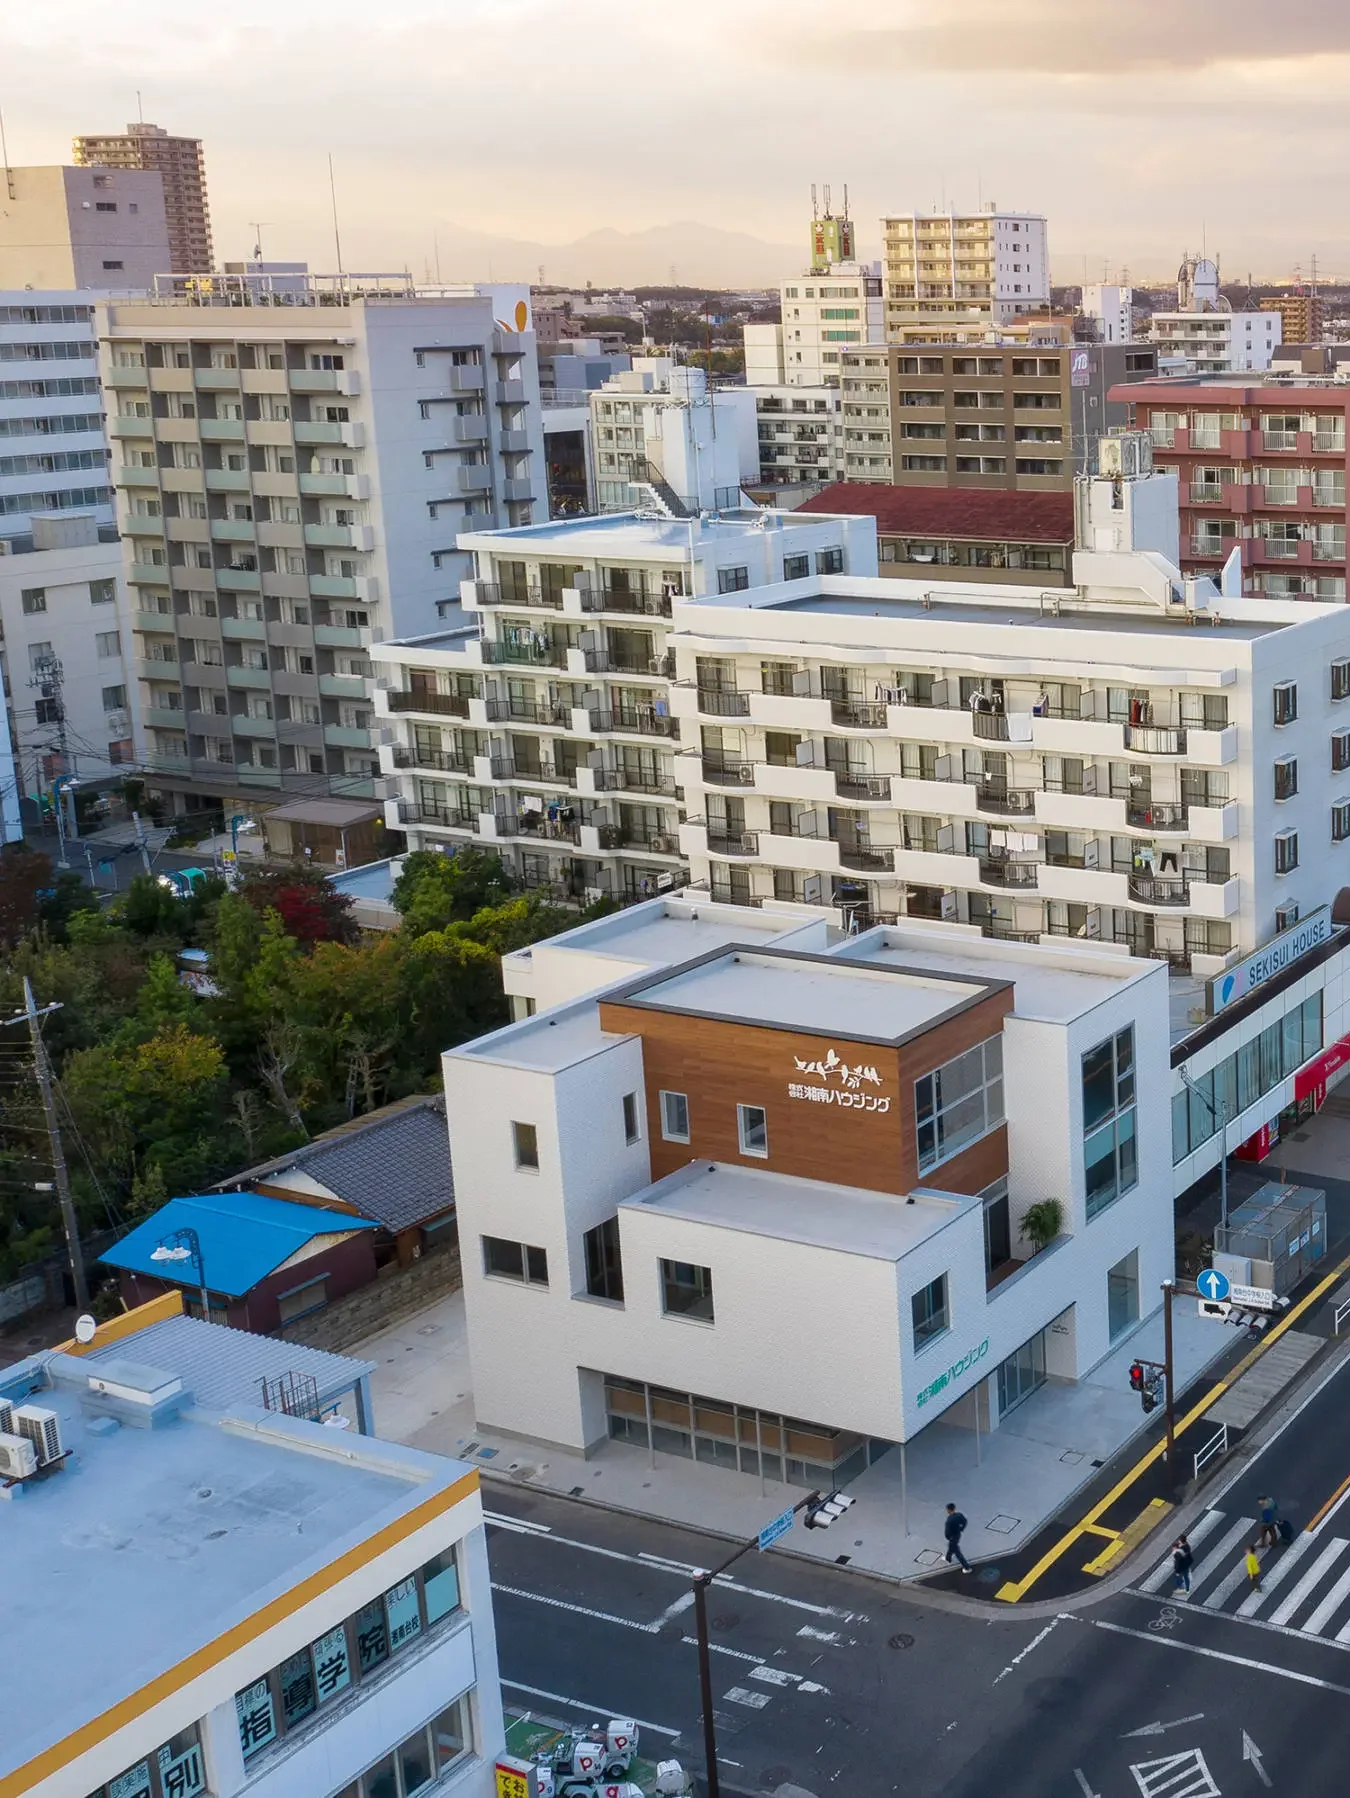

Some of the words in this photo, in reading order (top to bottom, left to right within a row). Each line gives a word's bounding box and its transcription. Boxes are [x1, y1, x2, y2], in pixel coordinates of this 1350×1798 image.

[1249, 943, 1289, 986] SEKISUI
[1292, 919, 1325, 957] HOUSE
[804, 1085, 891, 1113] 湘南ハウジング
